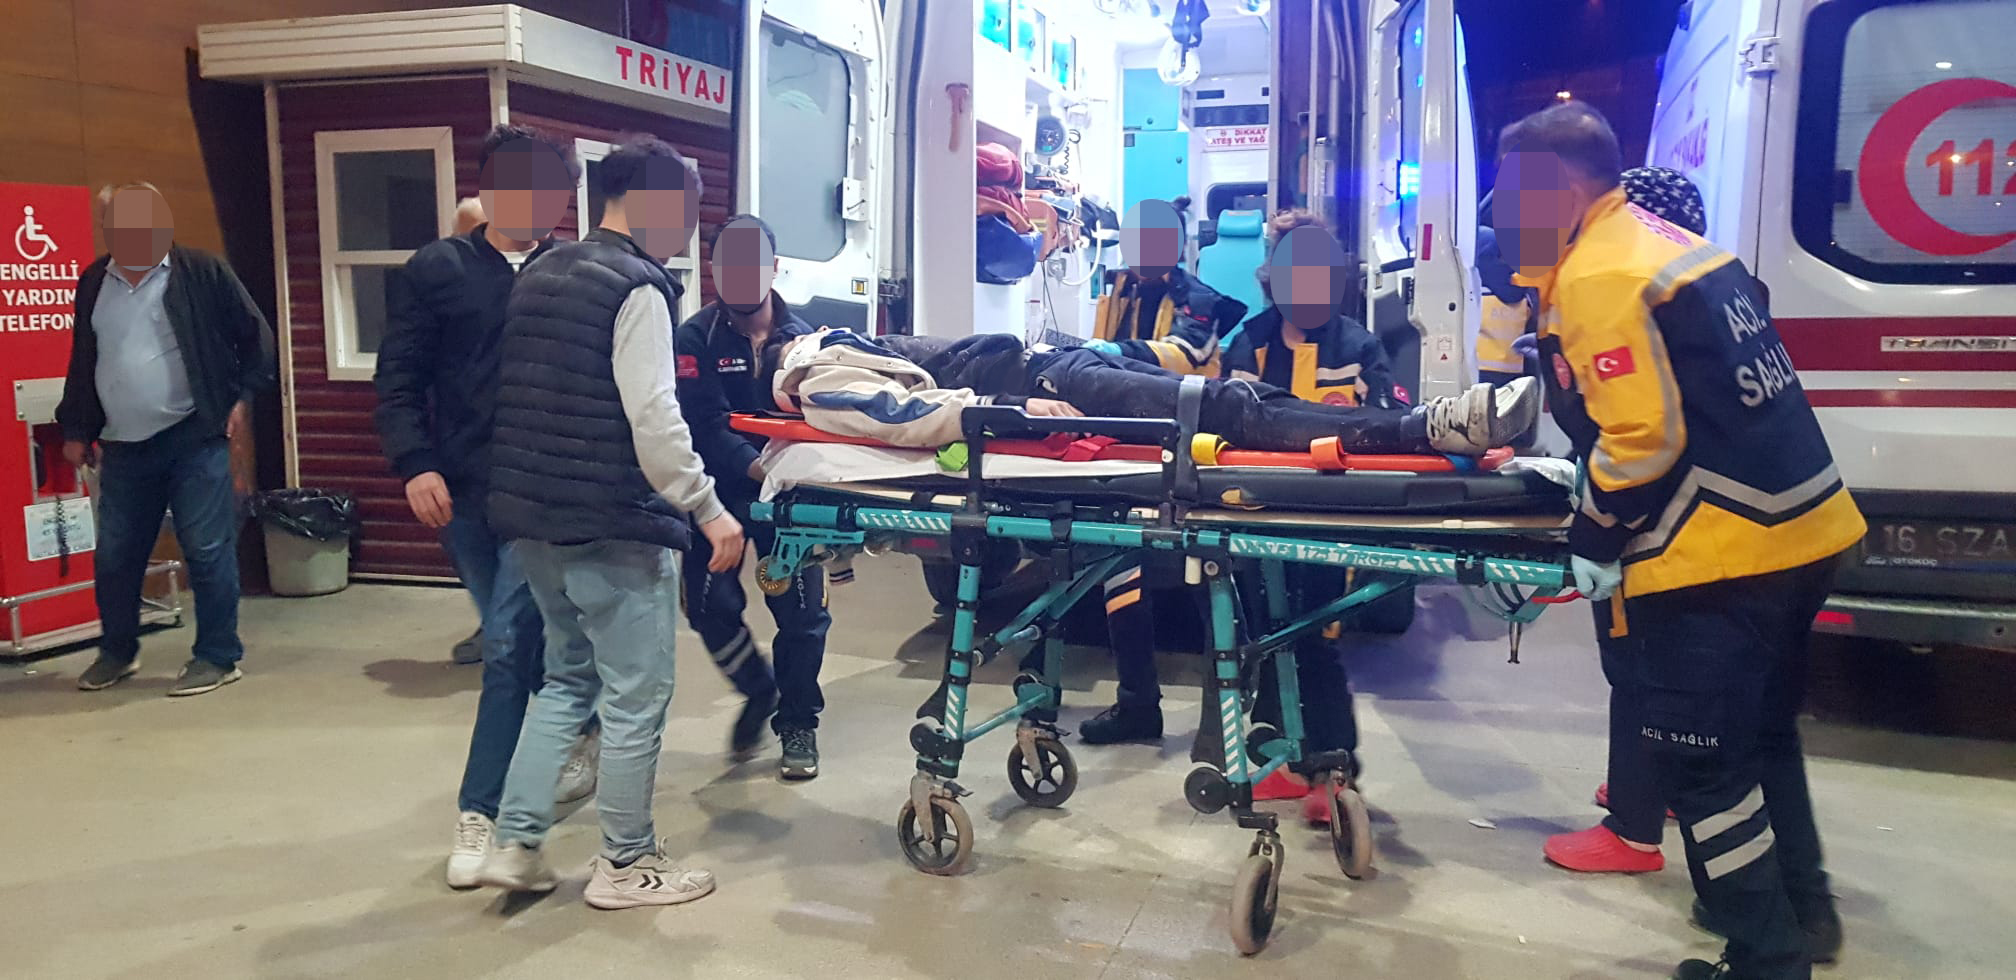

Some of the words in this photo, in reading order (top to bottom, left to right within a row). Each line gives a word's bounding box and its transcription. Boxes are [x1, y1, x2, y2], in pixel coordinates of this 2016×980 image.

[1234, 136, 1246, 144] VE
[0, 259, 80, 281] ENGELLİ
[0, 313, 75, 332] TELEFON
[1735, 341, 1796, 407] SAĞLI
[1882, 525, 1916, 553] 16
